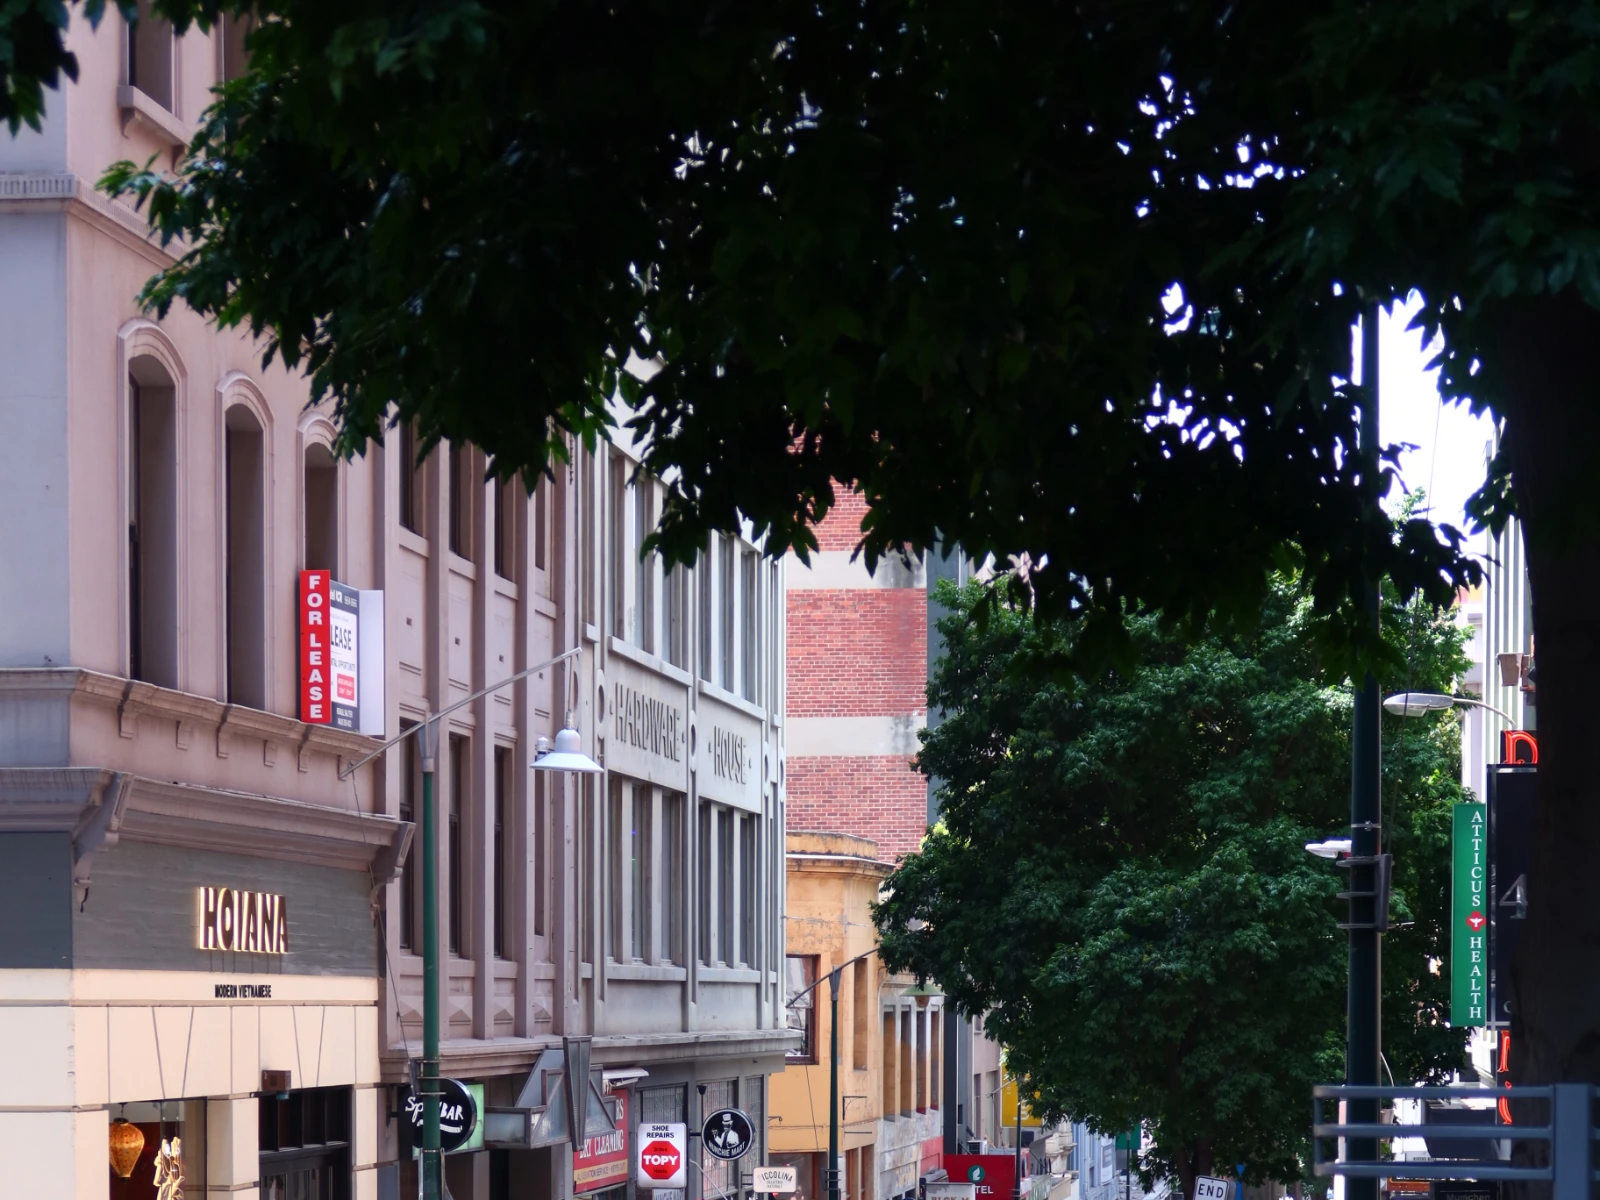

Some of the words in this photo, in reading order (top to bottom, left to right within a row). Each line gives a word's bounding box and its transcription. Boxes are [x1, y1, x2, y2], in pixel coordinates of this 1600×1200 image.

[307, 575, 323, 625] FOR
[308, 633, 323, 719] LEASE
[614, 682, 681, 763] HARDWARE
[713, 725, 747, 785] HOUSE
[1470, 811, 1484, 907] ATTICUS
[199, 886, 289, 954] HOIANA
[214, 984, 238, 998] MODERN
[238, 984, 272, 998] VIETNAMESE
[1469, 937, 1482, 1019] HEALTH
[643, 1155, 679, 1166] TOPY
[708, 1139, 731, 1157] MUNCHIE
[731, 1141, 746, 1156] MART
[1198, 1183, 1224, 1199] END
